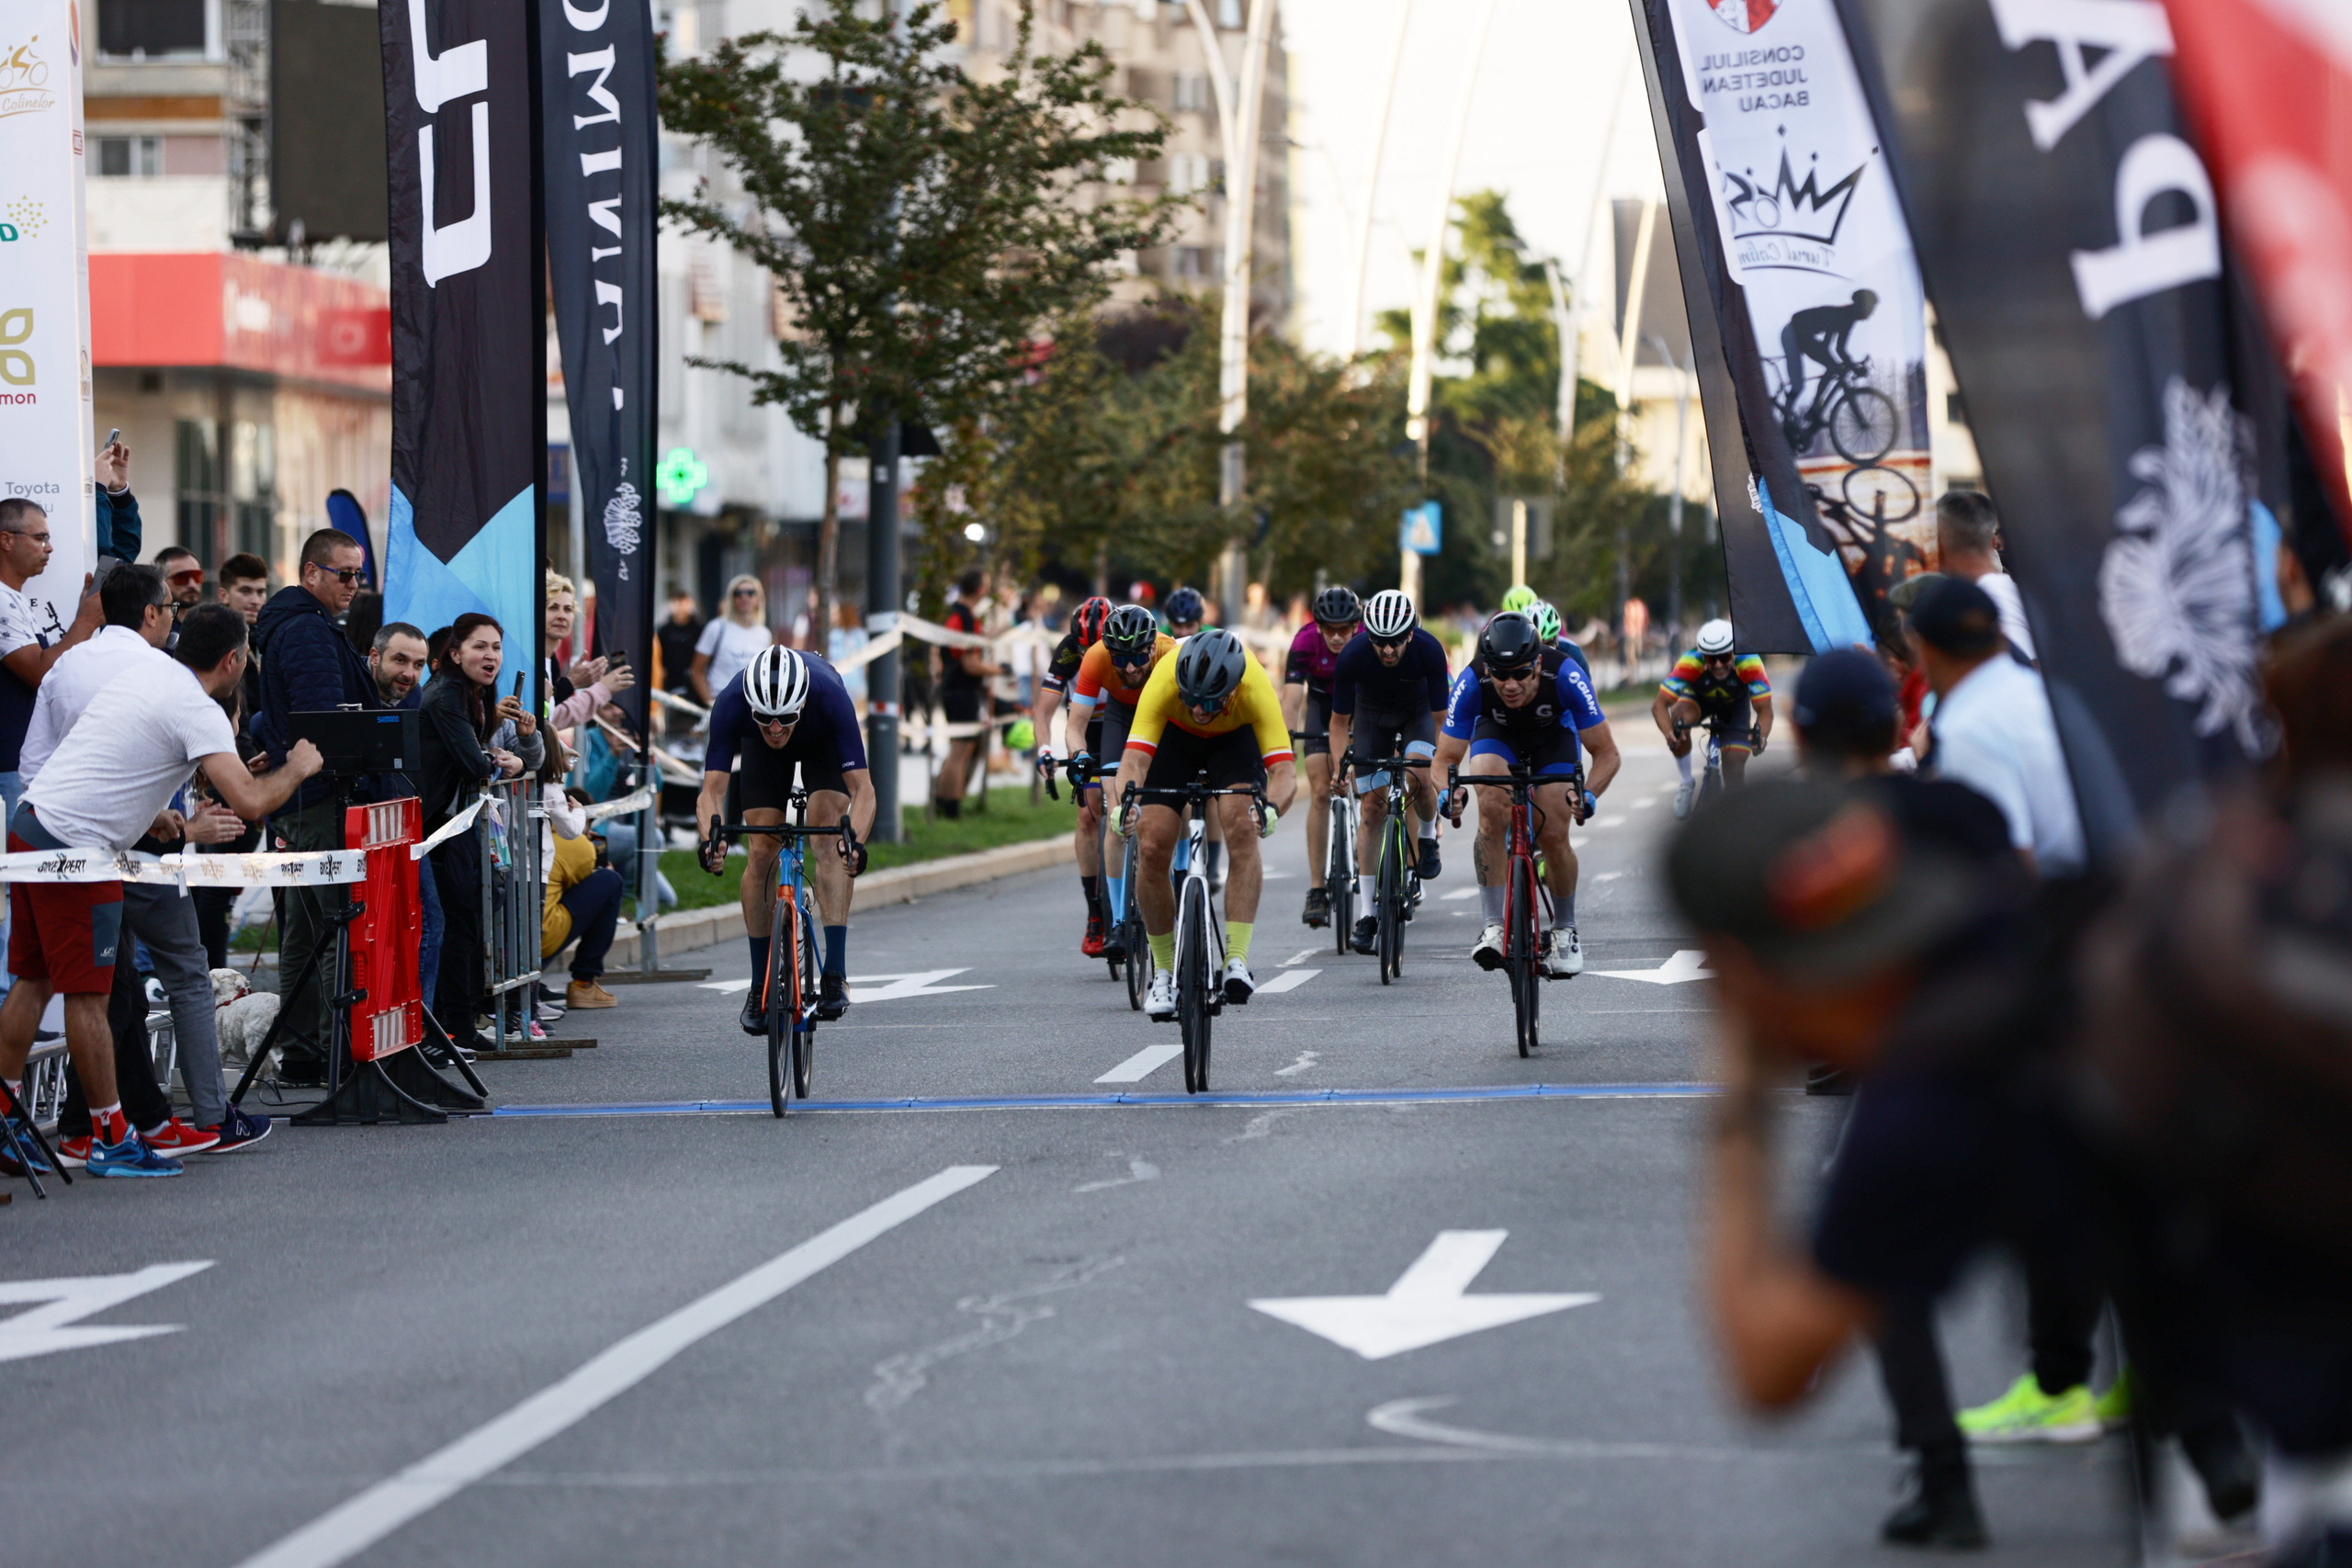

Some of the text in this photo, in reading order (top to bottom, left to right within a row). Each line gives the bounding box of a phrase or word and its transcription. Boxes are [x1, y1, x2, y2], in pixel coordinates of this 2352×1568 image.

[2, 92, 55, 112] Colinelor
[5, 481, 60, 498] Toyota
[1448, 679, 1466, 719] GIANT
[1577, 680, 1598, 716] GIANT
